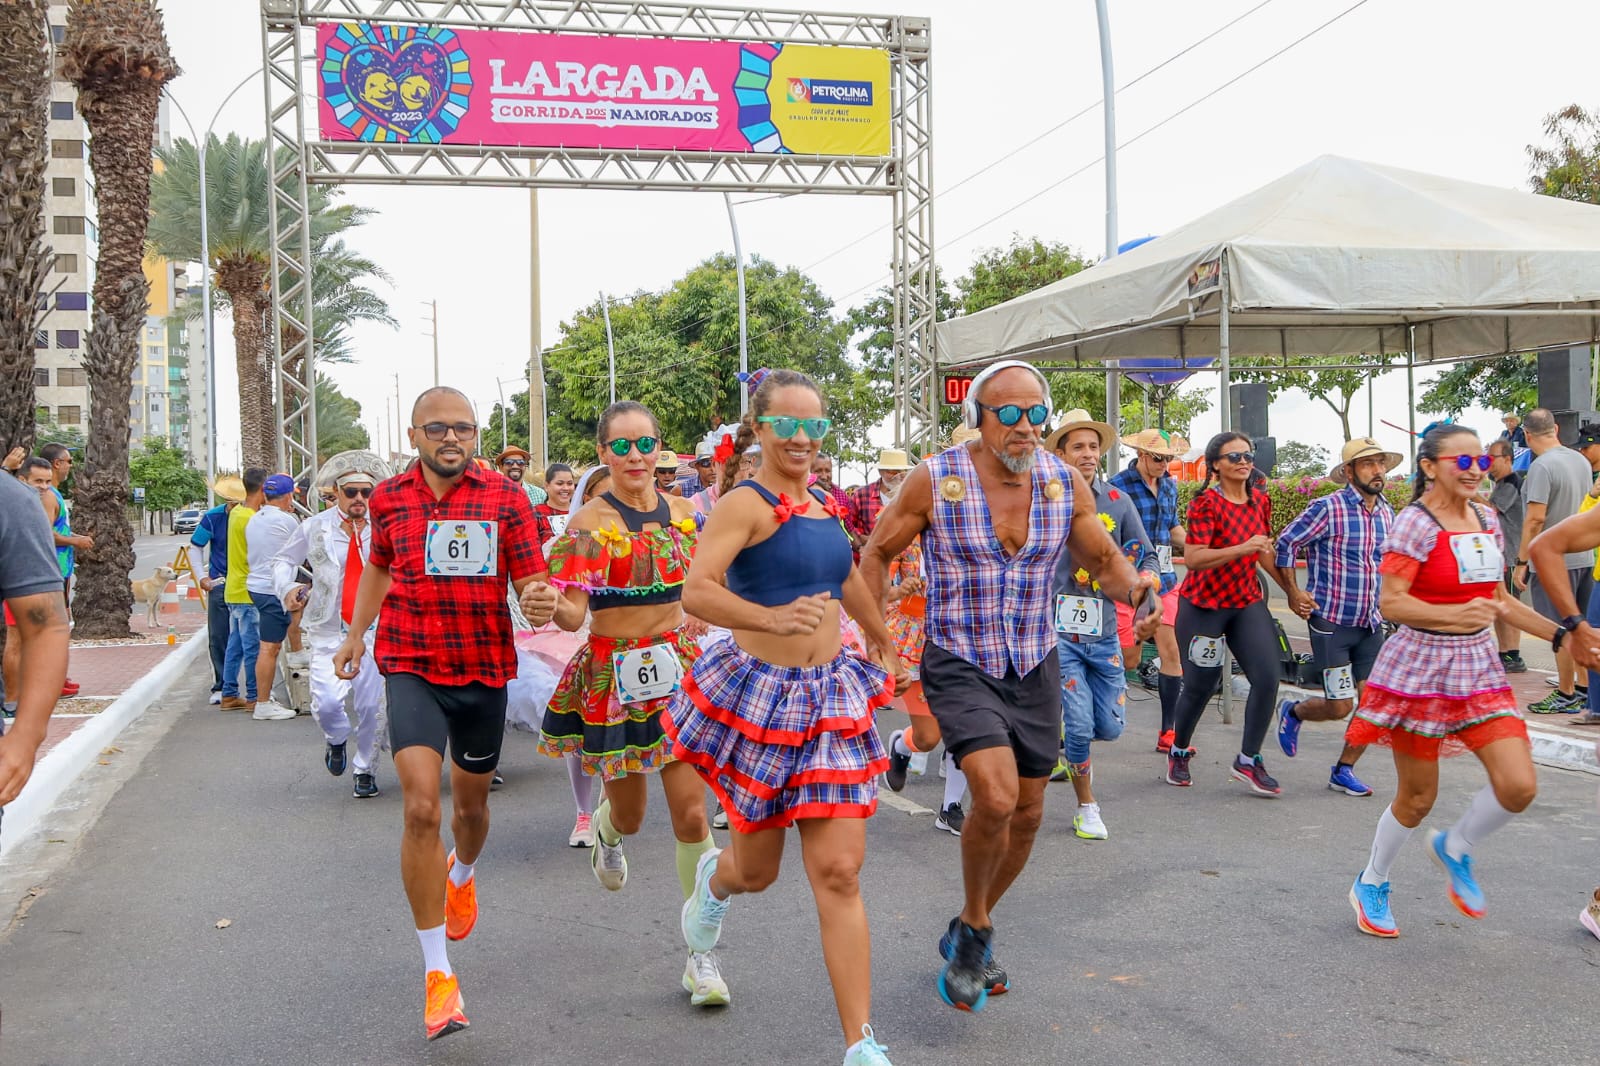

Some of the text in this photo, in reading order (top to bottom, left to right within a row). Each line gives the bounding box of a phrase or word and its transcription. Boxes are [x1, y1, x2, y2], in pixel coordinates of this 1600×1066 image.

[488, 59, 719, 101] LARGADA
[812, 85, 869, 100] PETROLINA
[391, 112, 423, 122] 2023
[500, 105, 713, 123] CORRIDA DOS NAMORADOS
[448, 540, 469, 559] 61
[1071, 608, 1087, 623] 79
[1201, 647, 1217, 659] 25
[637, 664, 659, 685] 61
[1338, 676, 1351, 689] 25
